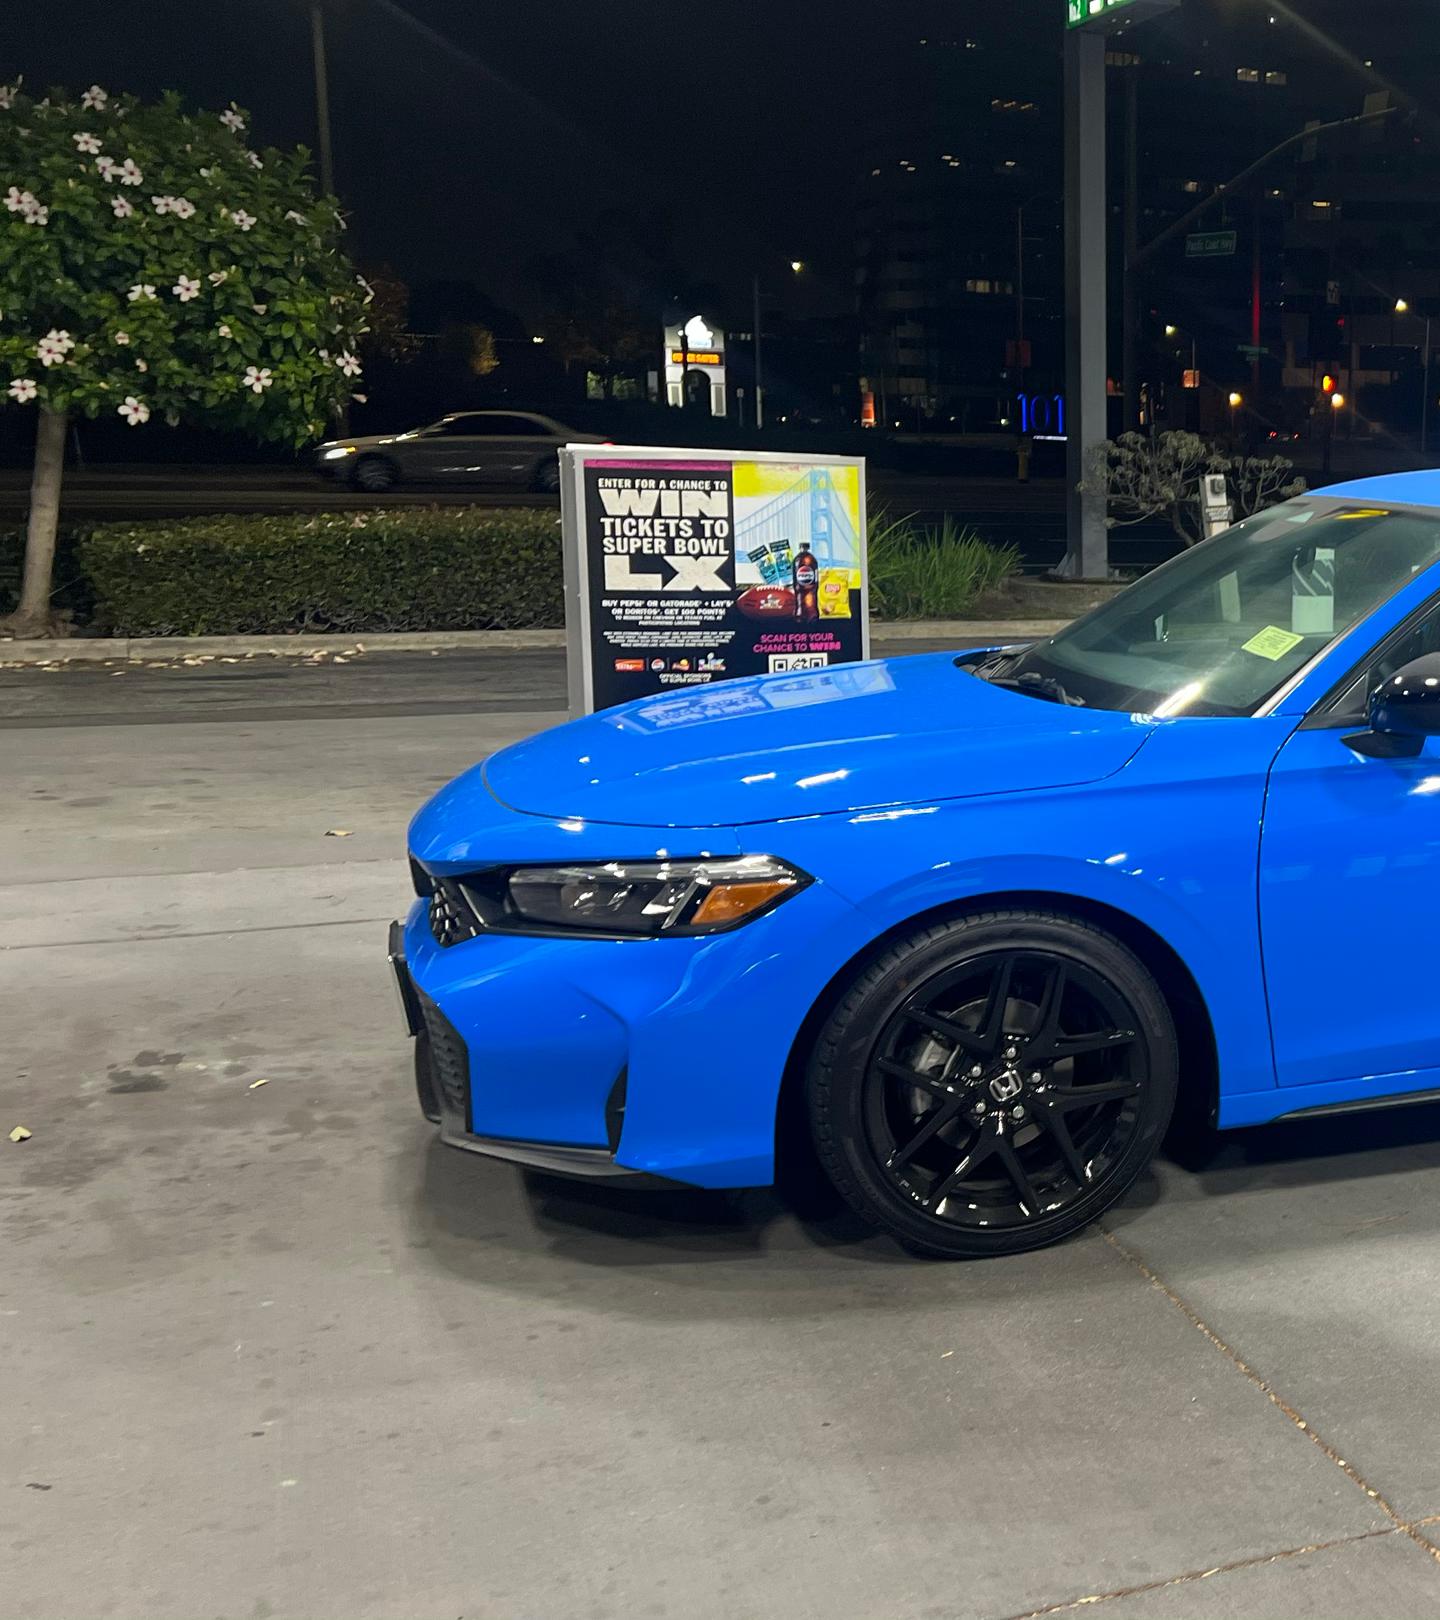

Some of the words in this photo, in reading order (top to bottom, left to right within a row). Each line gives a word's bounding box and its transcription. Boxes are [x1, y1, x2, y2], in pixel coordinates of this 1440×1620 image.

[598, 478, 631, 488] ENTER
[635, 479, 655, 489] FOR
[659, 480, 667, 489] A
[670, 480, 711, 490] CHANCE
[714, 481, 728, 490] TO
[598, 488, 729, 518] WIN
[600, 518, 693, 538] TICKETS
[700, 519, 729, 538] TO
[602, 537, 667, 554] SUPER
[674, 538, 730, 555] BOWL
[604, 554, 732, 591] LX
[761, 633, 787, 643] SCAN
[788, 633, 807, 642] FOR
[809, 632, 834, 641] YOUR
[753, 643, 793, 653] CHANCE
[794, 643, 807, 651] TO
